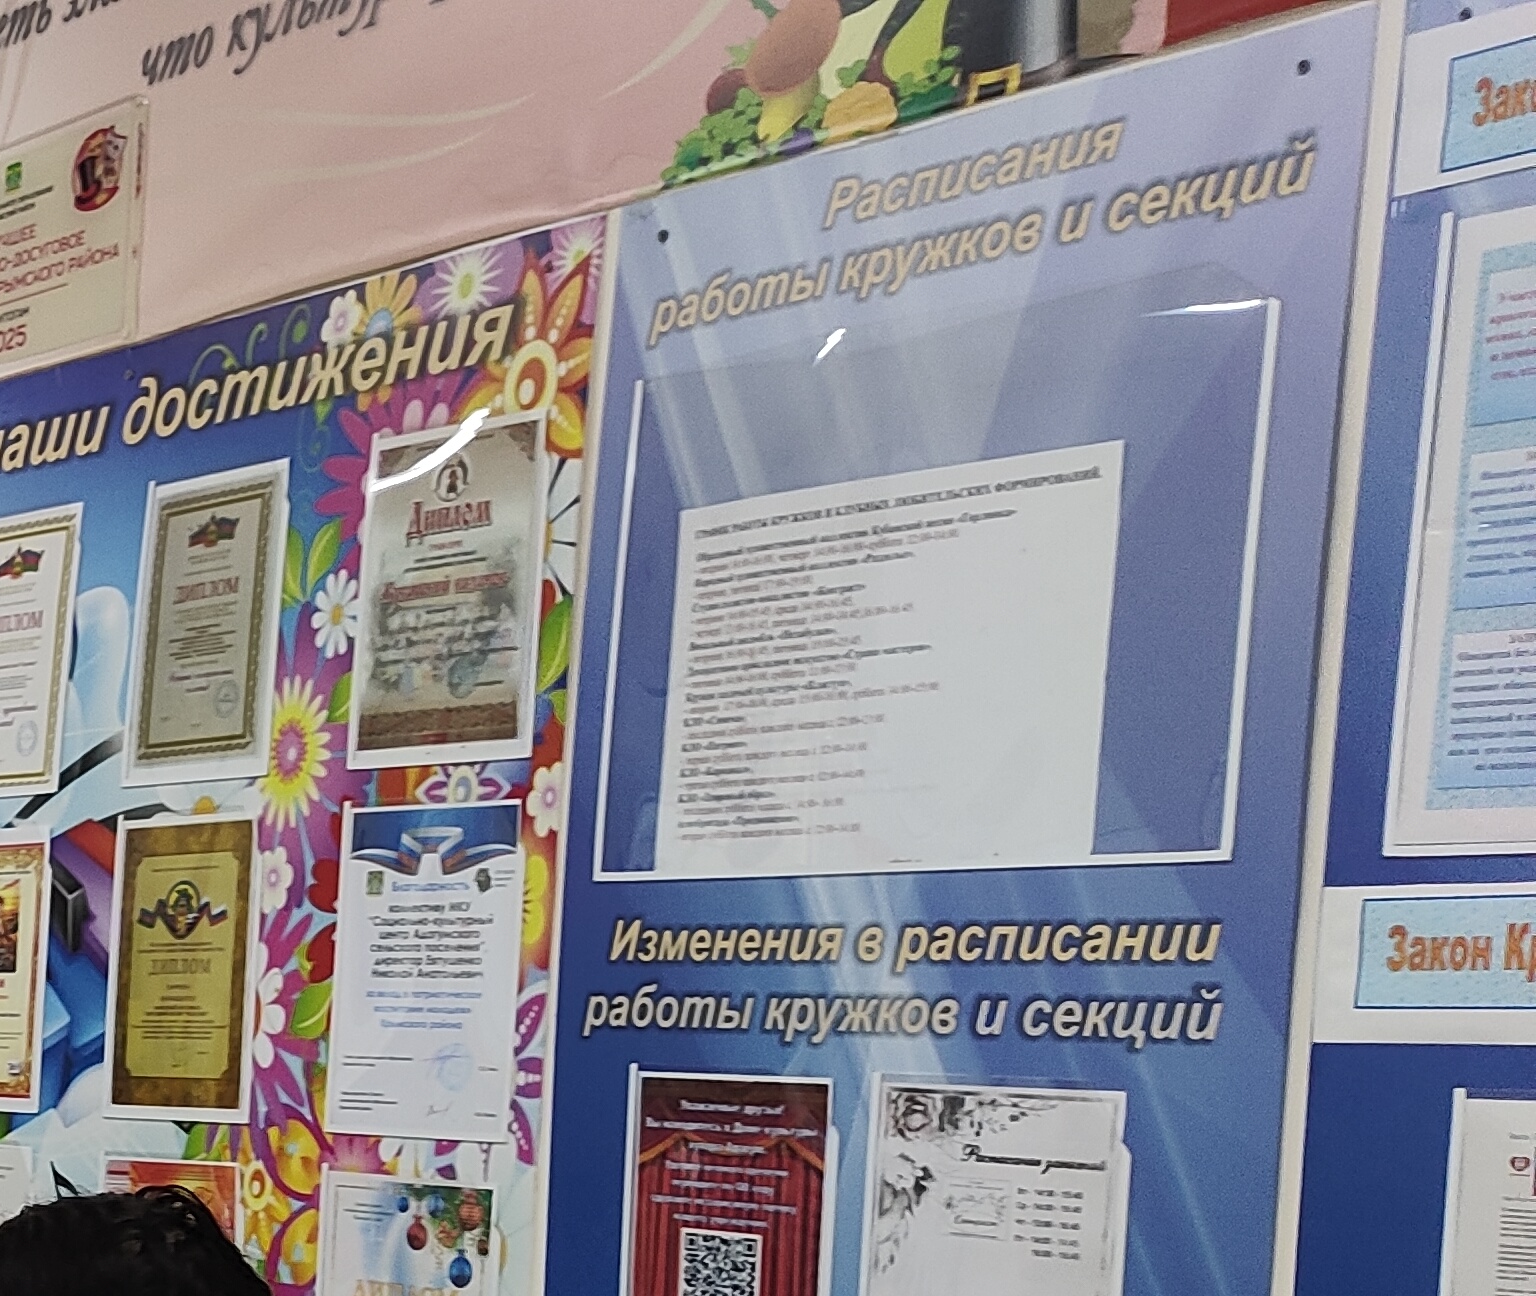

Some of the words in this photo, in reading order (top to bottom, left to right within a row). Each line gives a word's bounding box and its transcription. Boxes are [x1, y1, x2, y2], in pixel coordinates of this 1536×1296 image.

[141, 26, 215, 86] что
[824, 118, 1126, 228] Расписания
[646, 260, 830, 347] работы
[840, 211, 1042, 298] кружков
[1058, 201, 1092, 244] и
[1107, 131, 1319, 234] секций
[123, 299, 516, 442] достижения
[610, 916, 842, 964] Изменения
[856, 927, 883, 962] в
[895, 915, 1222, 973] расписании
[1386, 924, 1493, 973] Закон
[582, 980, 753, 1039] работы
[764, 992, 960, 1045] кружков
[974, 995, 1009, 1035] и
[1021, 984, 1223, 1049] секций
